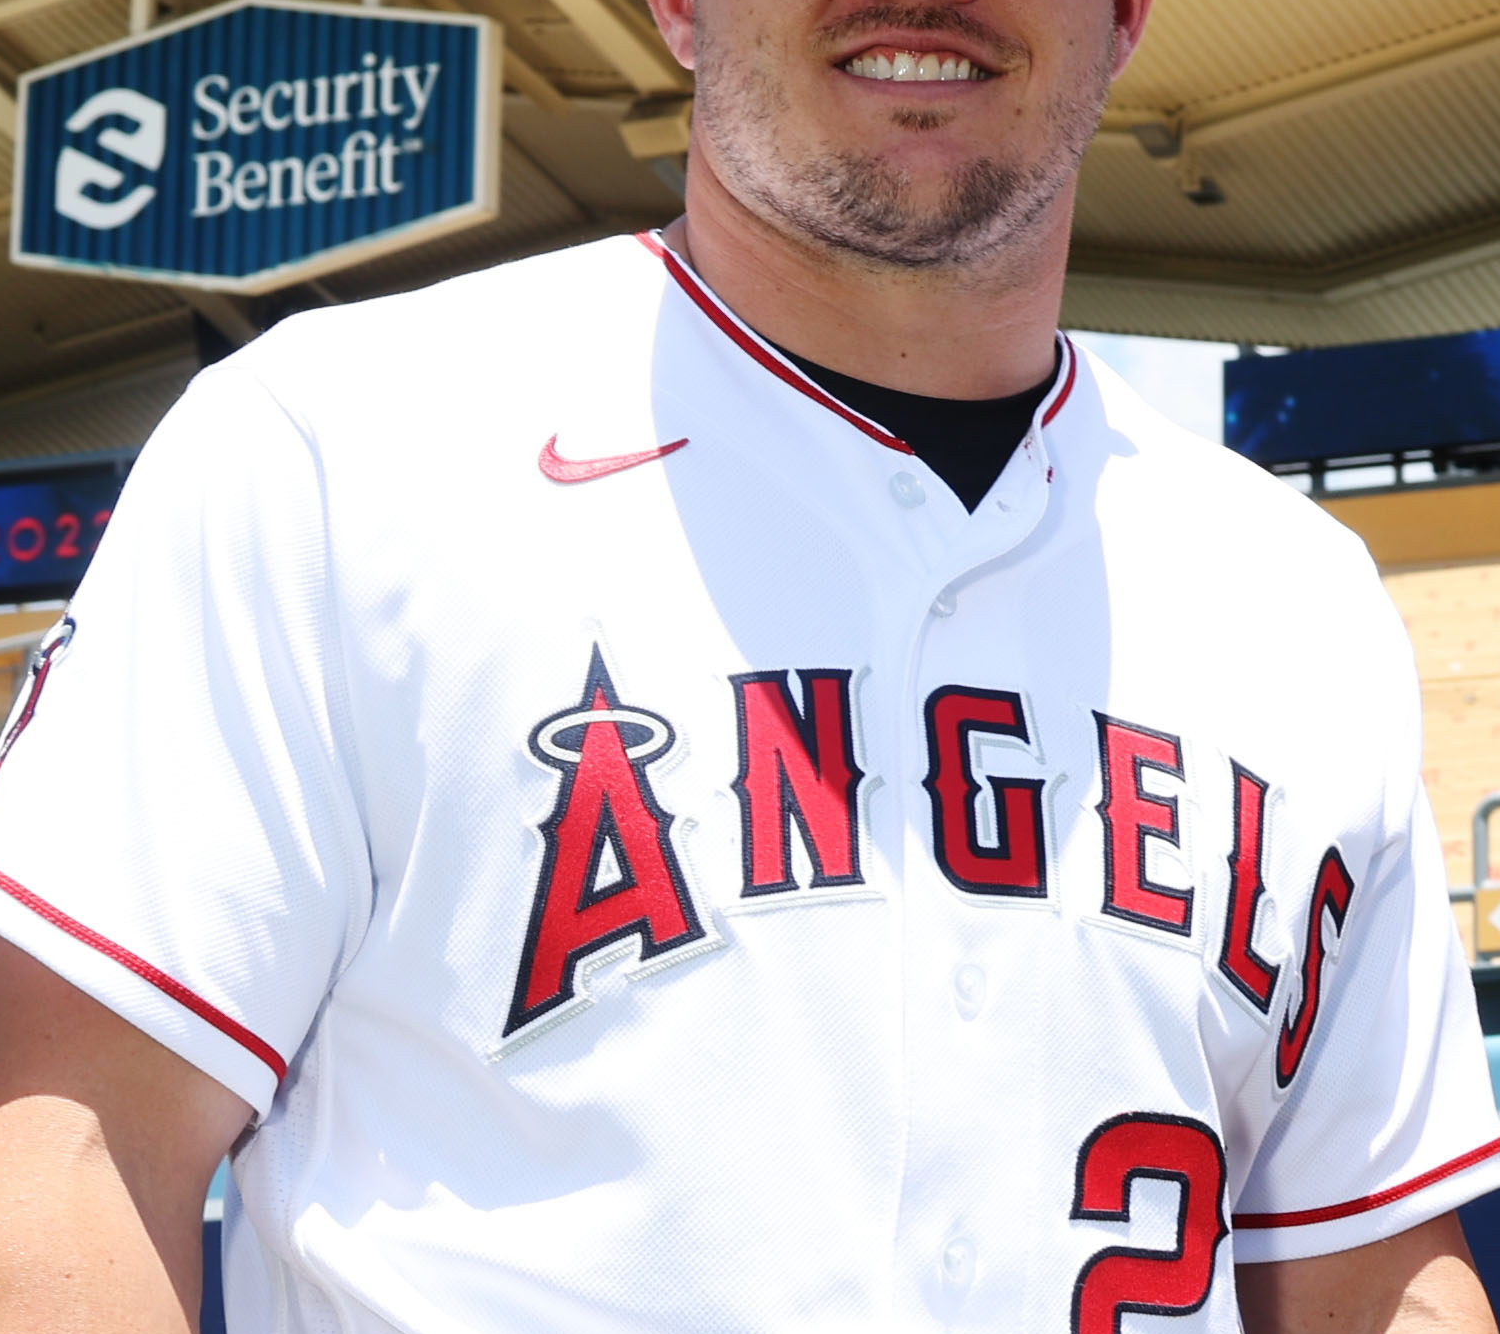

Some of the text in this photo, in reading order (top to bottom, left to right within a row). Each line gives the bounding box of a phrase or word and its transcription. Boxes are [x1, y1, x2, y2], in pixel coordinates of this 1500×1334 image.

[192, 52, 440, 140] Security
[192, 130, 404, 217] Benefit
[500, 639, 1358, 1092] ANGELS
